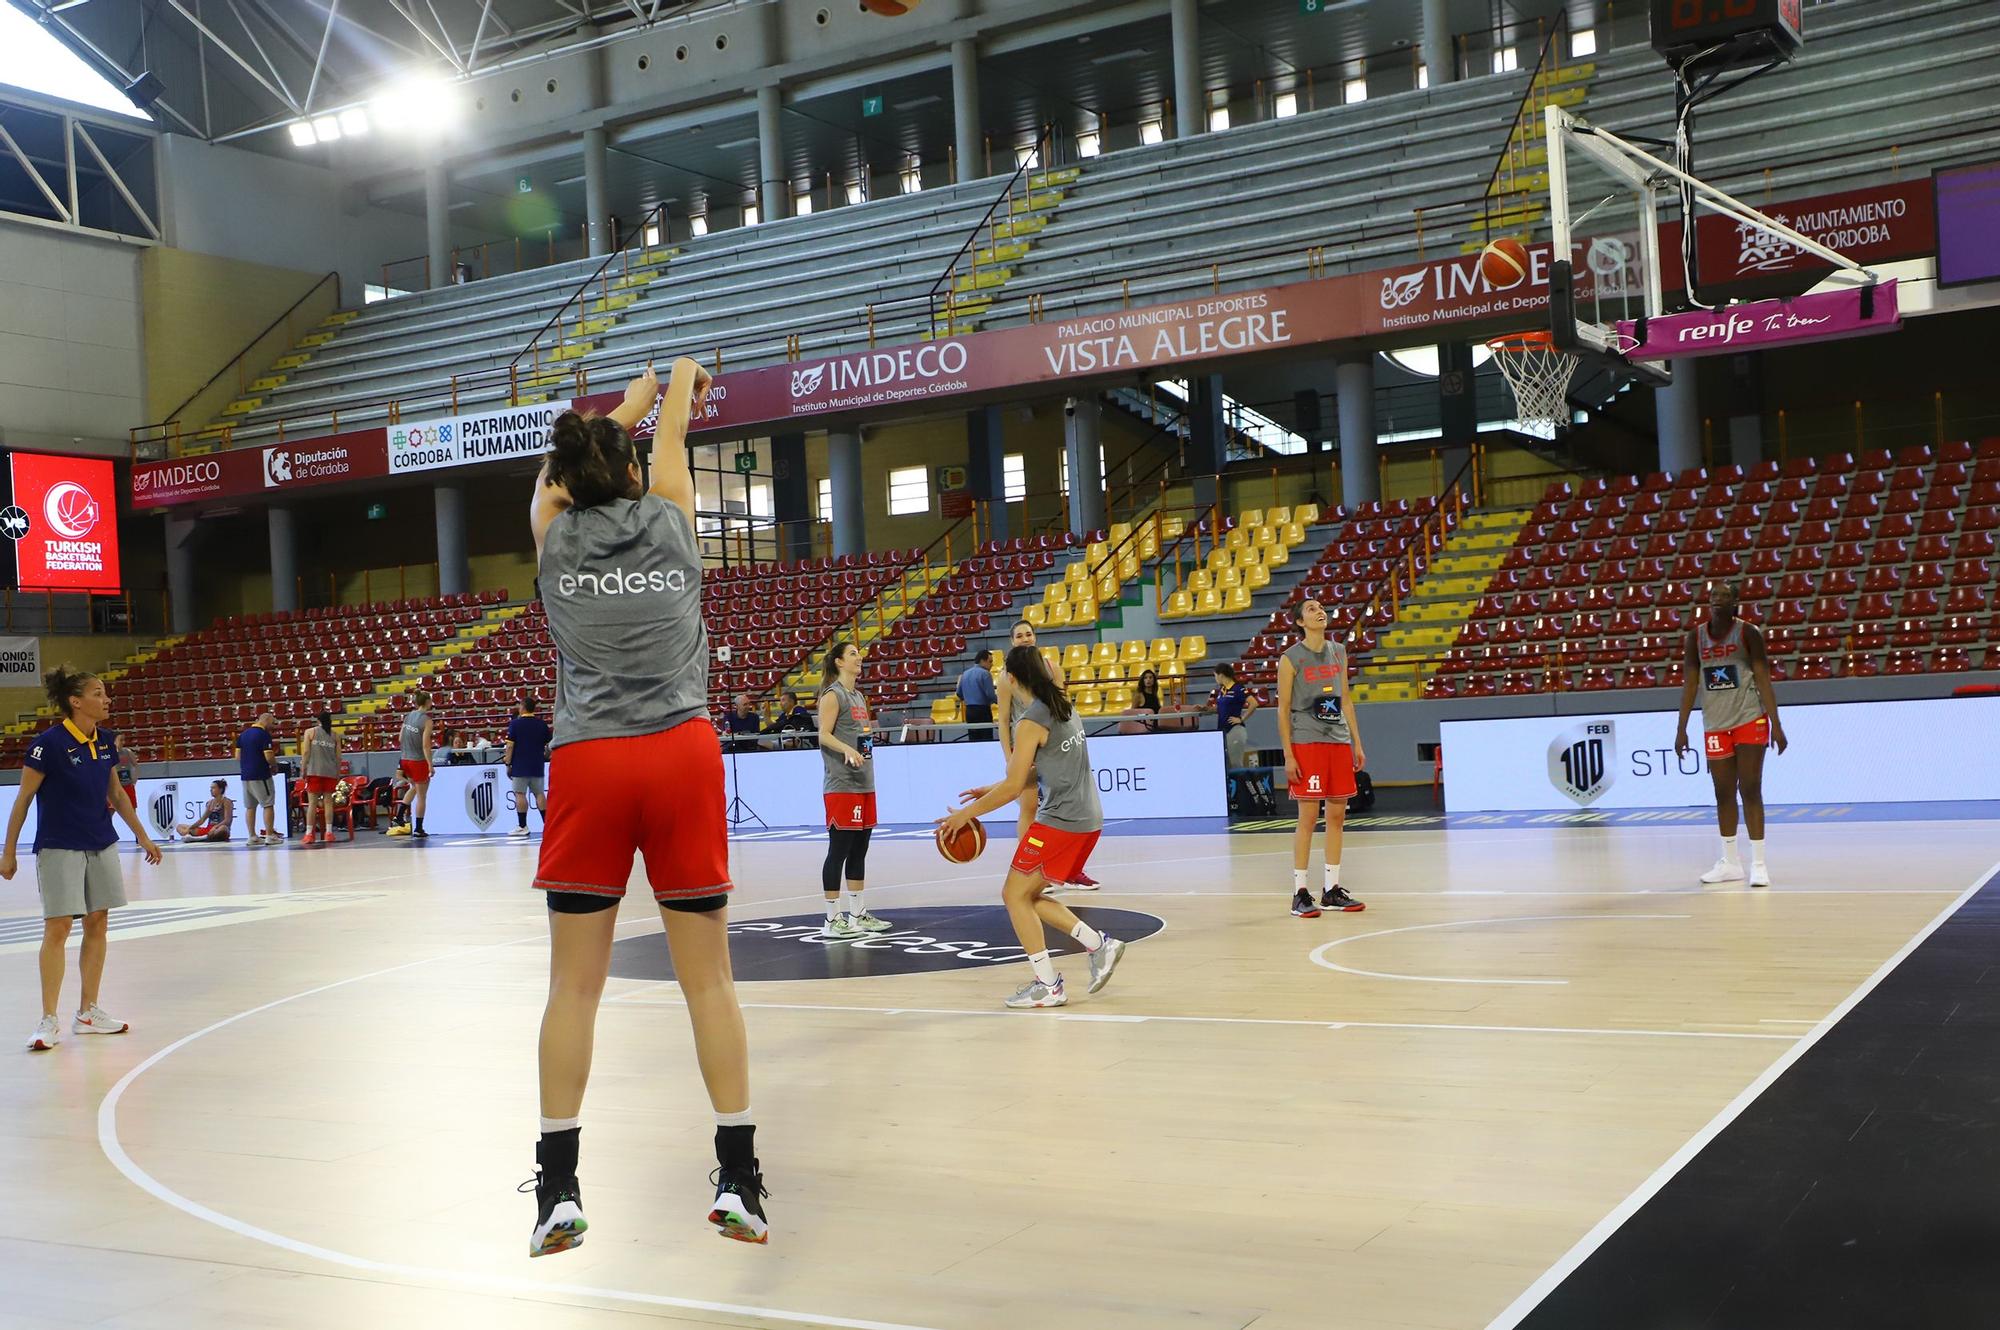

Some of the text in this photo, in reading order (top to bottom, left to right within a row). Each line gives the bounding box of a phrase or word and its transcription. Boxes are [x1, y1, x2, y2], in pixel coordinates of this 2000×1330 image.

[1306, 0, 1317, 11] 8
[869, 99, 877, 113] 7
[519, 179, 527, 191] 6
[1795, 198, 1906, 233] AYUNTAMIENTO
[1058, 294, 1268, 338] PALACIO MUNICIPAL DEPORTES
[1382, 311, 1430, 328] Instituto
[1432, 302, 1491, 321] Municipal
[1493, 299, 1510, 312] de
[1679, 312, 1831, 344] renfe Tu tren
[1044, 310, 1292, 375] VISTA ALEGRE
[829, 342, 968, 391] IMDECO
[792, 380, 968, 413] Instituto Municipal de Deportes Córdoba
[462, 409, 554, 438] PATRIMONIO
[463, 428, 555, 459] HUMANIDA
[294, 447, 348, 465] Diputación
[394, 447, 453, 468] CÓRDOBA
[740, 456, 751, 469] G
[152, 461, 220, 489] IMDECO
[295, 462, 349, 479] de Córdoba
[45, 540, 101, 554] TURKISH
[45, 552, 102, 562] BASKETBALL
[46, 561, 103, 571] FEDERATION
[559, 567, 686, 596] endesa
[1701, 643, 1738, 660] ESP
[1303, 663, 1343, 684] ESP
[1586, 724, 1611, 735] FEB
[1560, 738, 1605, 792] 100
[1631, 748, 1712, 777] STO
[483, 771, 496, 779] FEB
[165, 784, 177, 792] FEB
[154, 793, 174, 829] 100
[471, 781, 494, 821] 100
